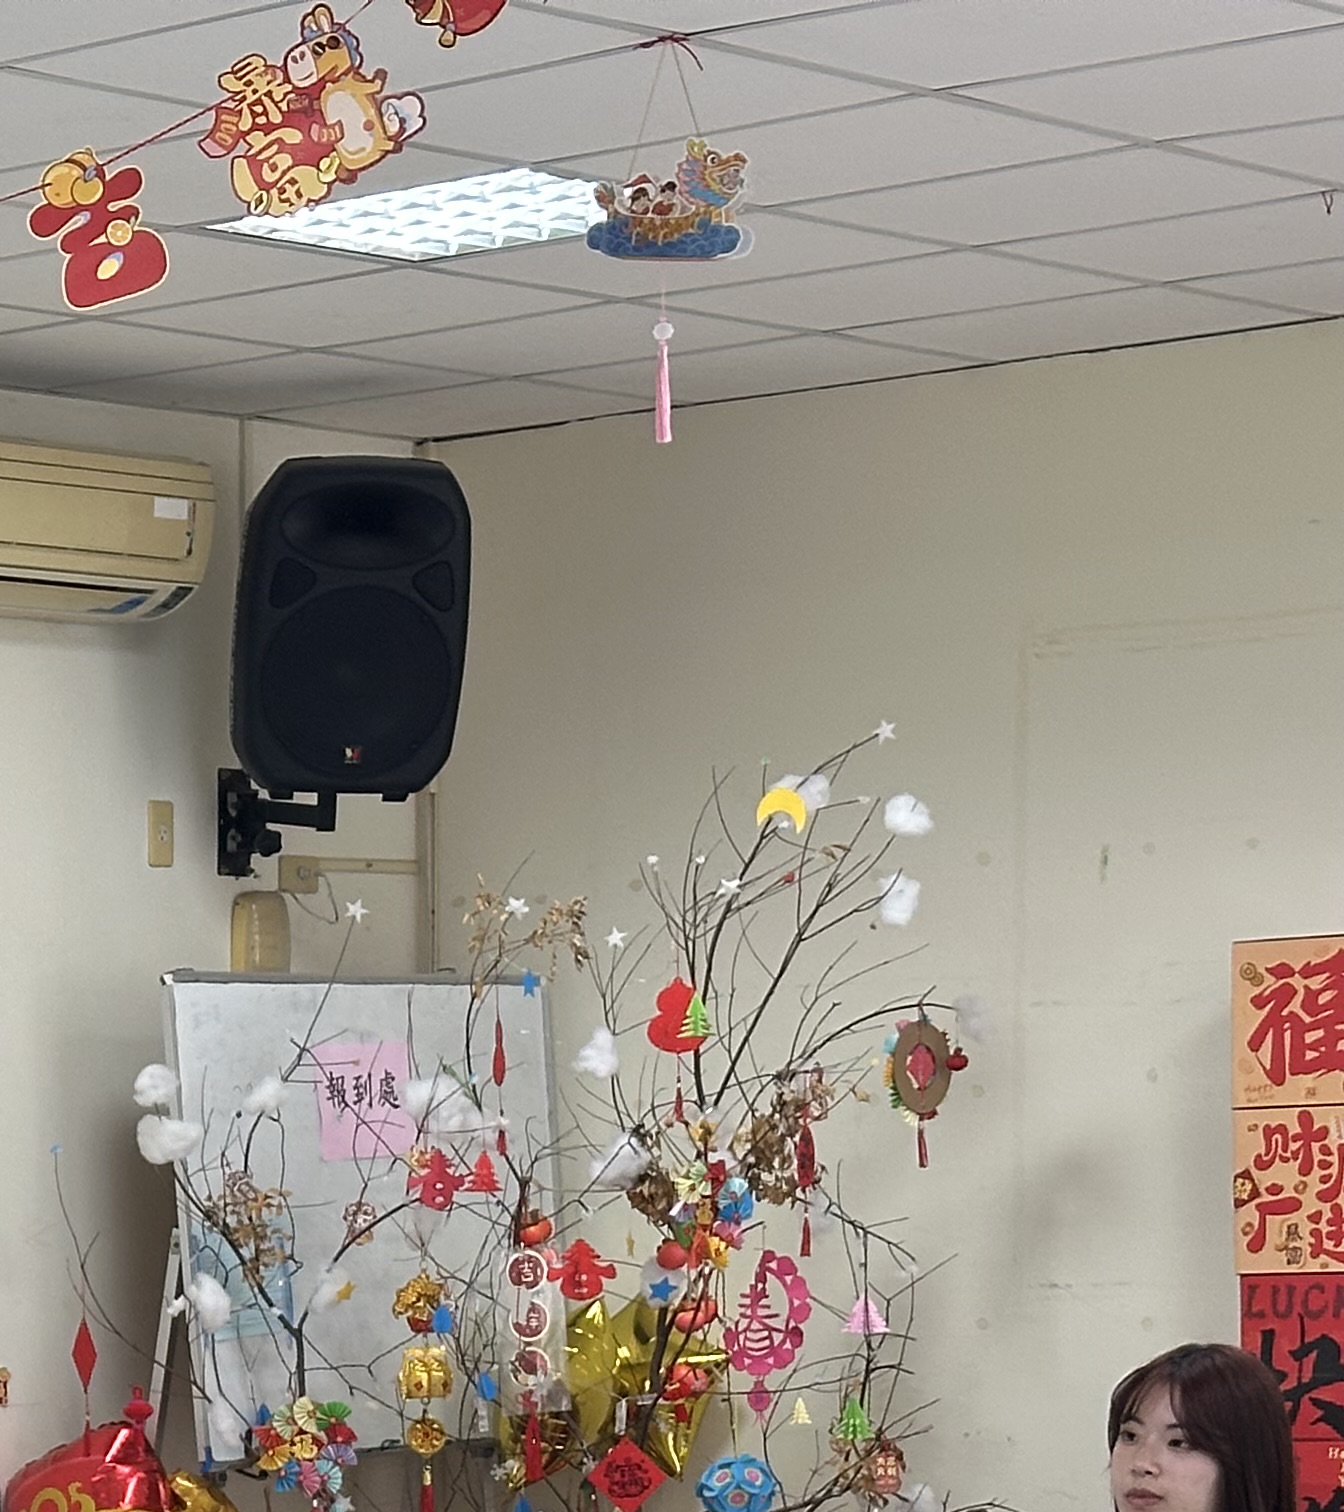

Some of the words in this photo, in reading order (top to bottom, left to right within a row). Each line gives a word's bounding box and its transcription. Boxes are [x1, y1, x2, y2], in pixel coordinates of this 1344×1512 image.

[28, 148, 169, 310] 吉
[325, 1070, 400, 1110] 報到處
